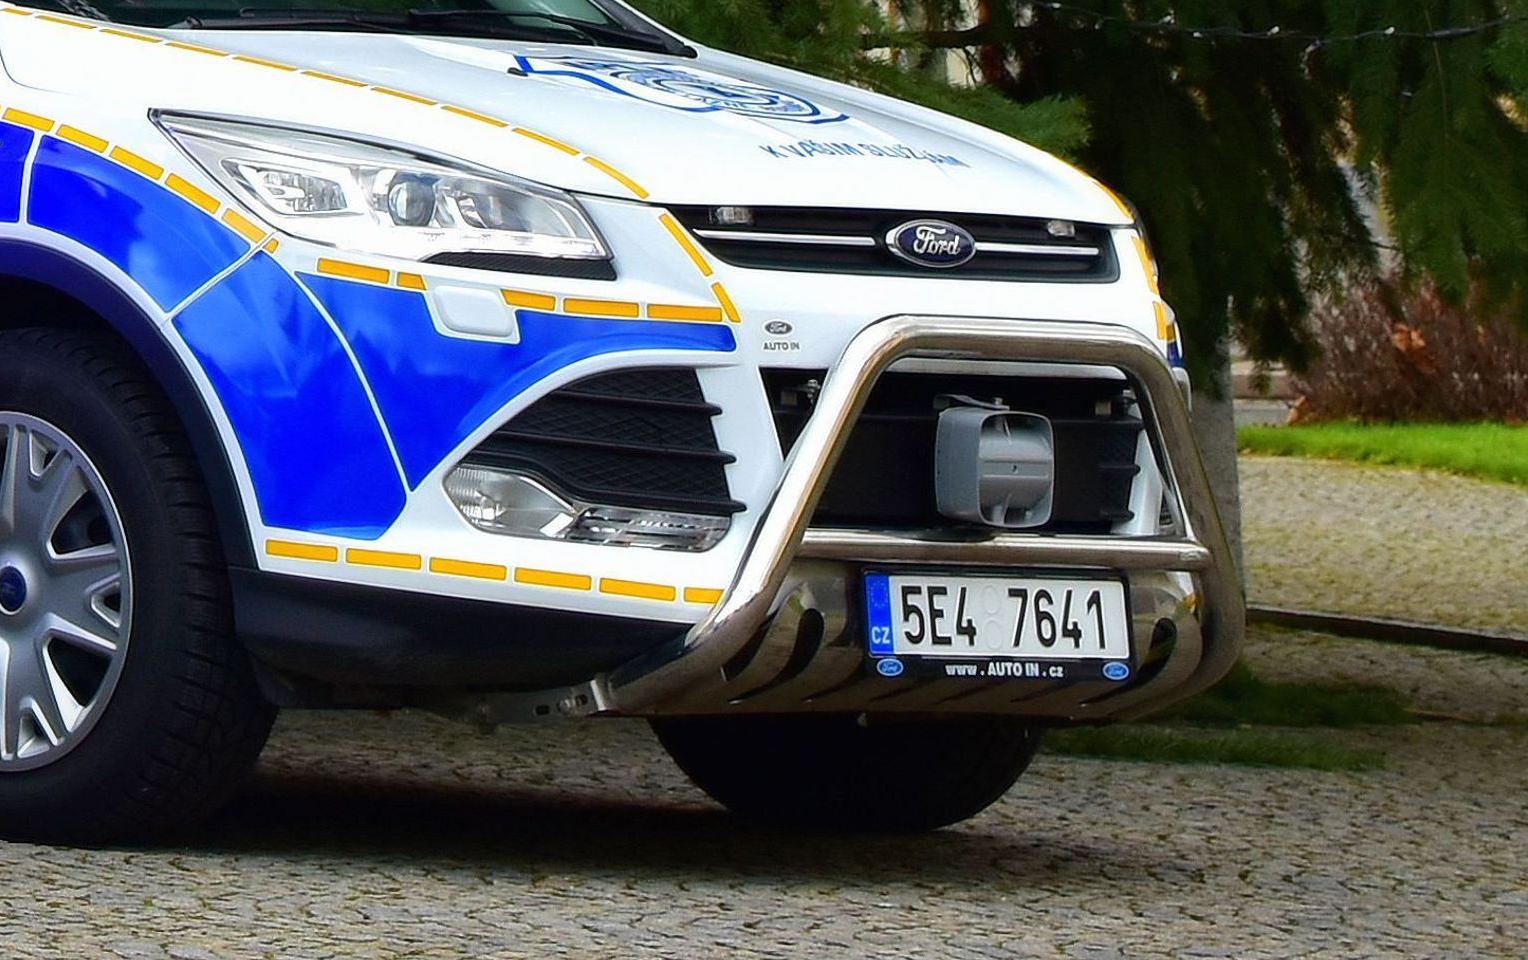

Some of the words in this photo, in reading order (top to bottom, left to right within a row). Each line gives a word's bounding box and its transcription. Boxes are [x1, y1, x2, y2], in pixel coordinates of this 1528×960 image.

[759, 145, 788, 158] K
[913, 226, 960, 255] Ford
[763, 342, 789, 350] AUTO
[791, 342, 800, 350] IN
[901, 586, 977, 646] 5E4
[1008, 588, 1106, 650] 7641
[871, 626, 890, 644] CZ
